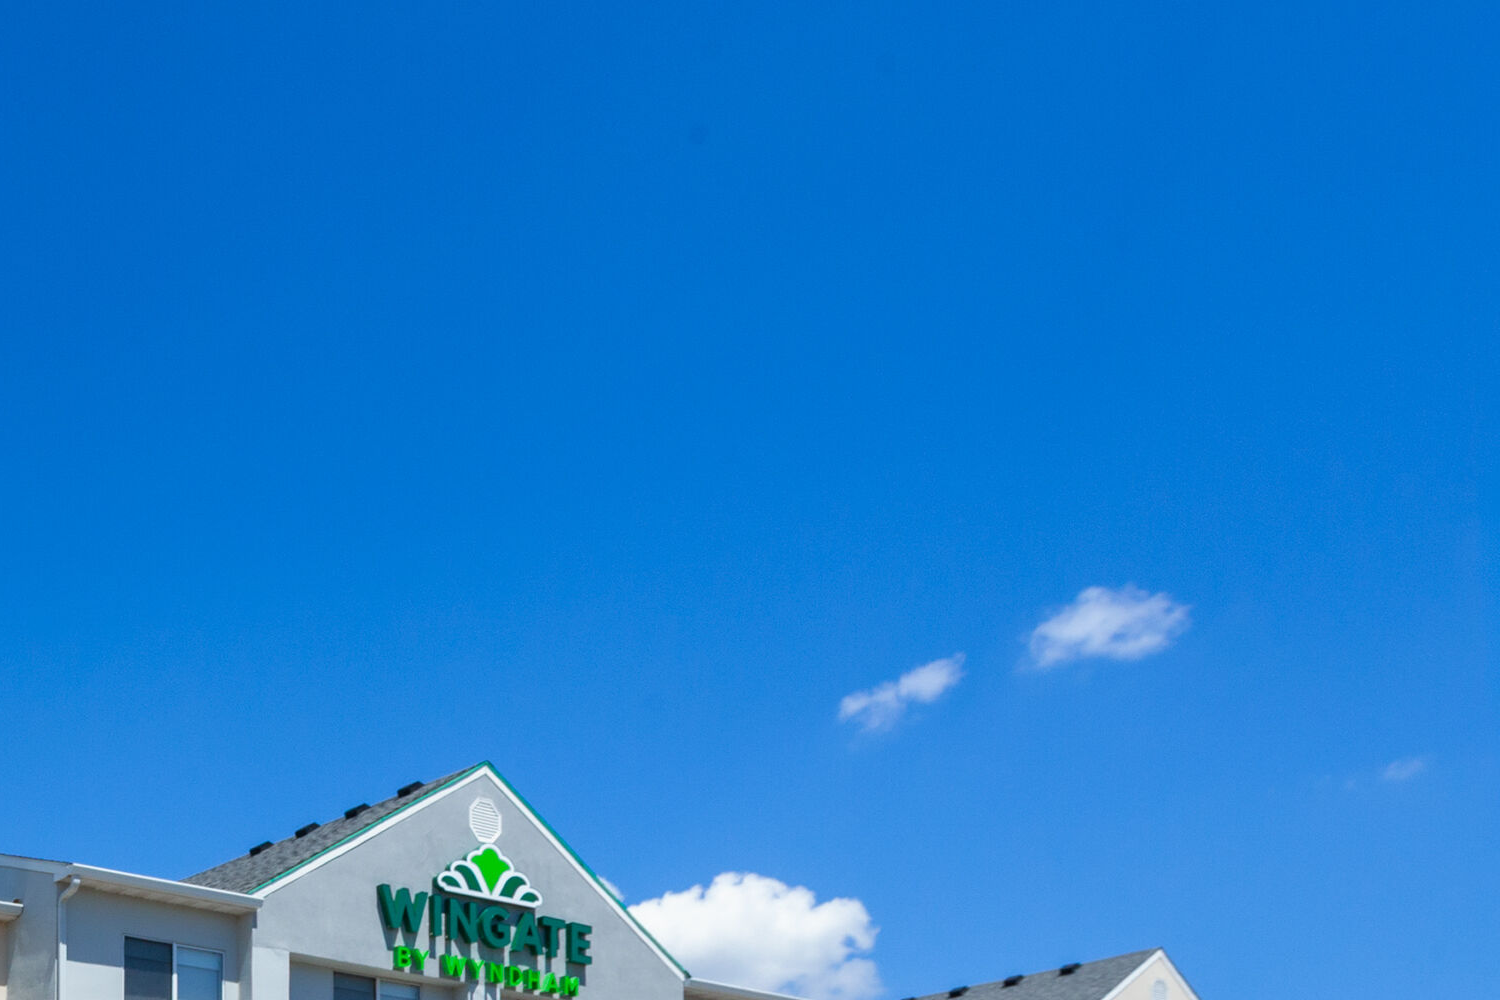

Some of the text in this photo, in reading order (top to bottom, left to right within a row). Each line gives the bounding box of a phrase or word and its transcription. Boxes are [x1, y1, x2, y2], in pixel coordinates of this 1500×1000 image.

[376, 883, 592, 965] WINGATE
[393, 945, 580, 997] BY WYNDHAM
